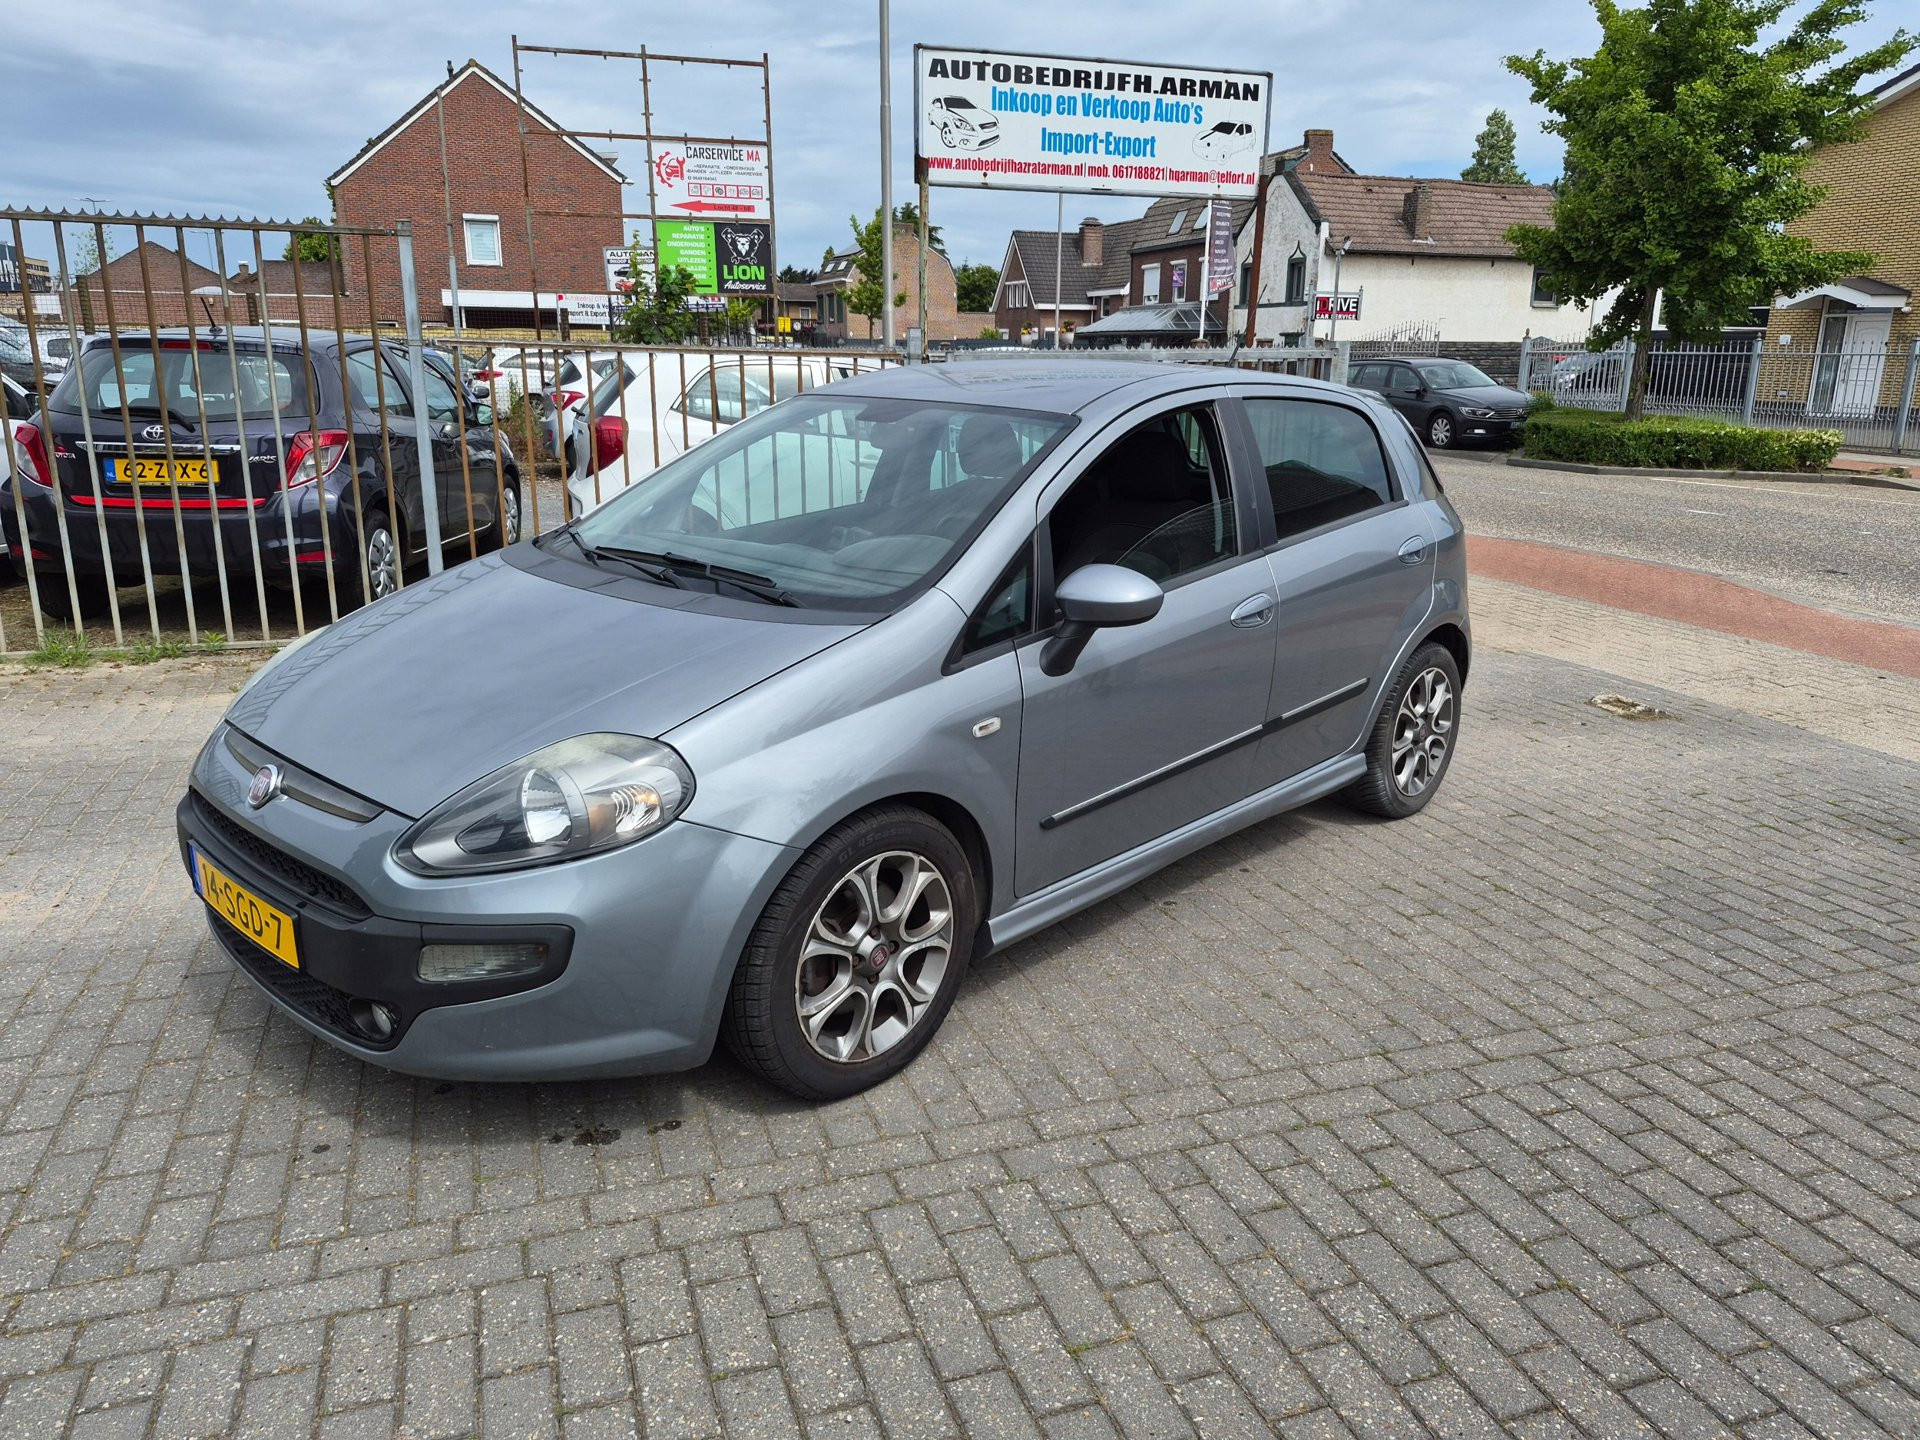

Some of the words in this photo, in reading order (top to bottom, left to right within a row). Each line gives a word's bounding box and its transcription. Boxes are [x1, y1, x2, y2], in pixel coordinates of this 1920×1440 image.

[928, 58, 1260, 102] AUTOBEDRIJFH.ARMAN
[991, 86, 1050, 116] Inkoop
[1056, 94, 1077, 116] en
[1081, 92, 1151, 124] Verkoop
[1153, 98, 1203, 125] Auto's
[1041, 127, 1156, 159] Import-Export
[686, 146, 744, 161] CARSERVICE
[746, 150, 761, 162] MA
[723, 265, 765, 280] LION
[724, 280, 767, 291] Autoservice
[577, 302, 595, 310] Inkoop
[590, 310, 606, 318] Export
[203, 863, 282, 950] 14-SGD-7
